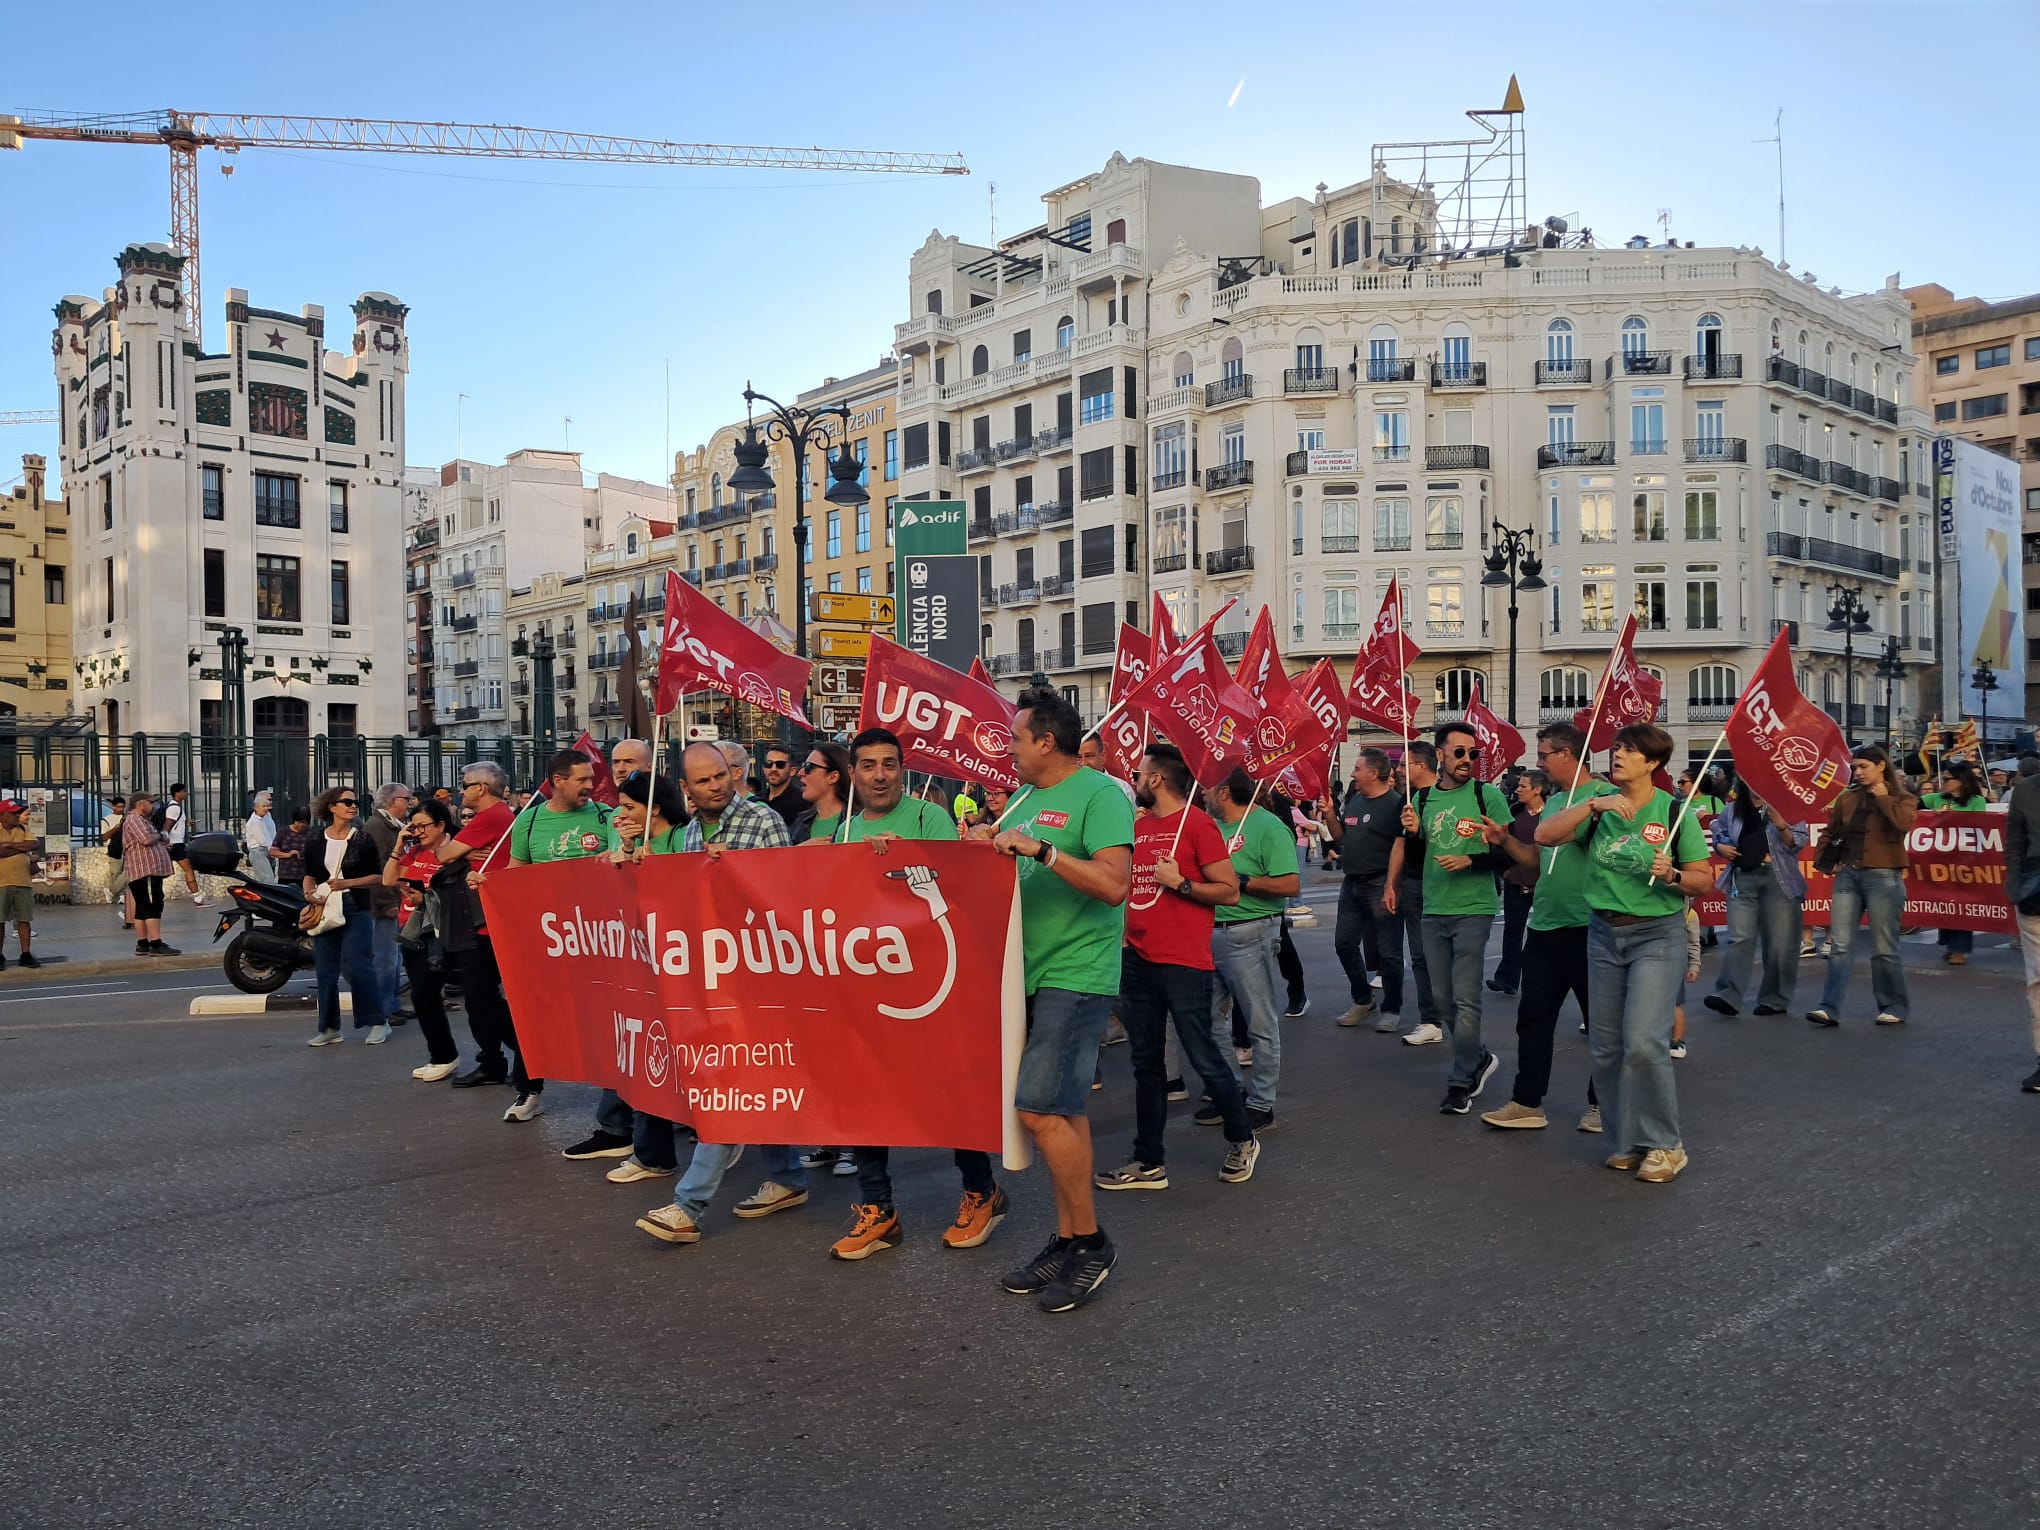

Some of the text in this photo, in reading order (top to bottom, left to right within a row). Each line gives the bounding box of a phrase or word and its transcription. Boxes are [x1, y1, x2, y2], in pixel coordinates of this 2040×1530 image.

[847, 406, 886, 432] ZENIT
[1996, 469, 2013, 493] Nou
[1971, 484, 2013, 516] d'Octubre
[921, 511, 962, 524] adif
[932, 594, 947, 639] NORD
[876, 681, 972, 741] UGT
[911, 737, 950, 757] País
[1747, 725, 1775, 751] País
[1039, 813, 1055, 822] UGT
[1645, 824, 1665, 835] UGT
[1703, 901, 1727, 913] PERS
[1965, 904, 2008, 919] SERVEIS
[541, 905, 626, 959] Salvem
[702, 908, 914, 989] pública
[688, 1087, 767, 1112] Públics
[772, 1087, 805, 1112] PV
